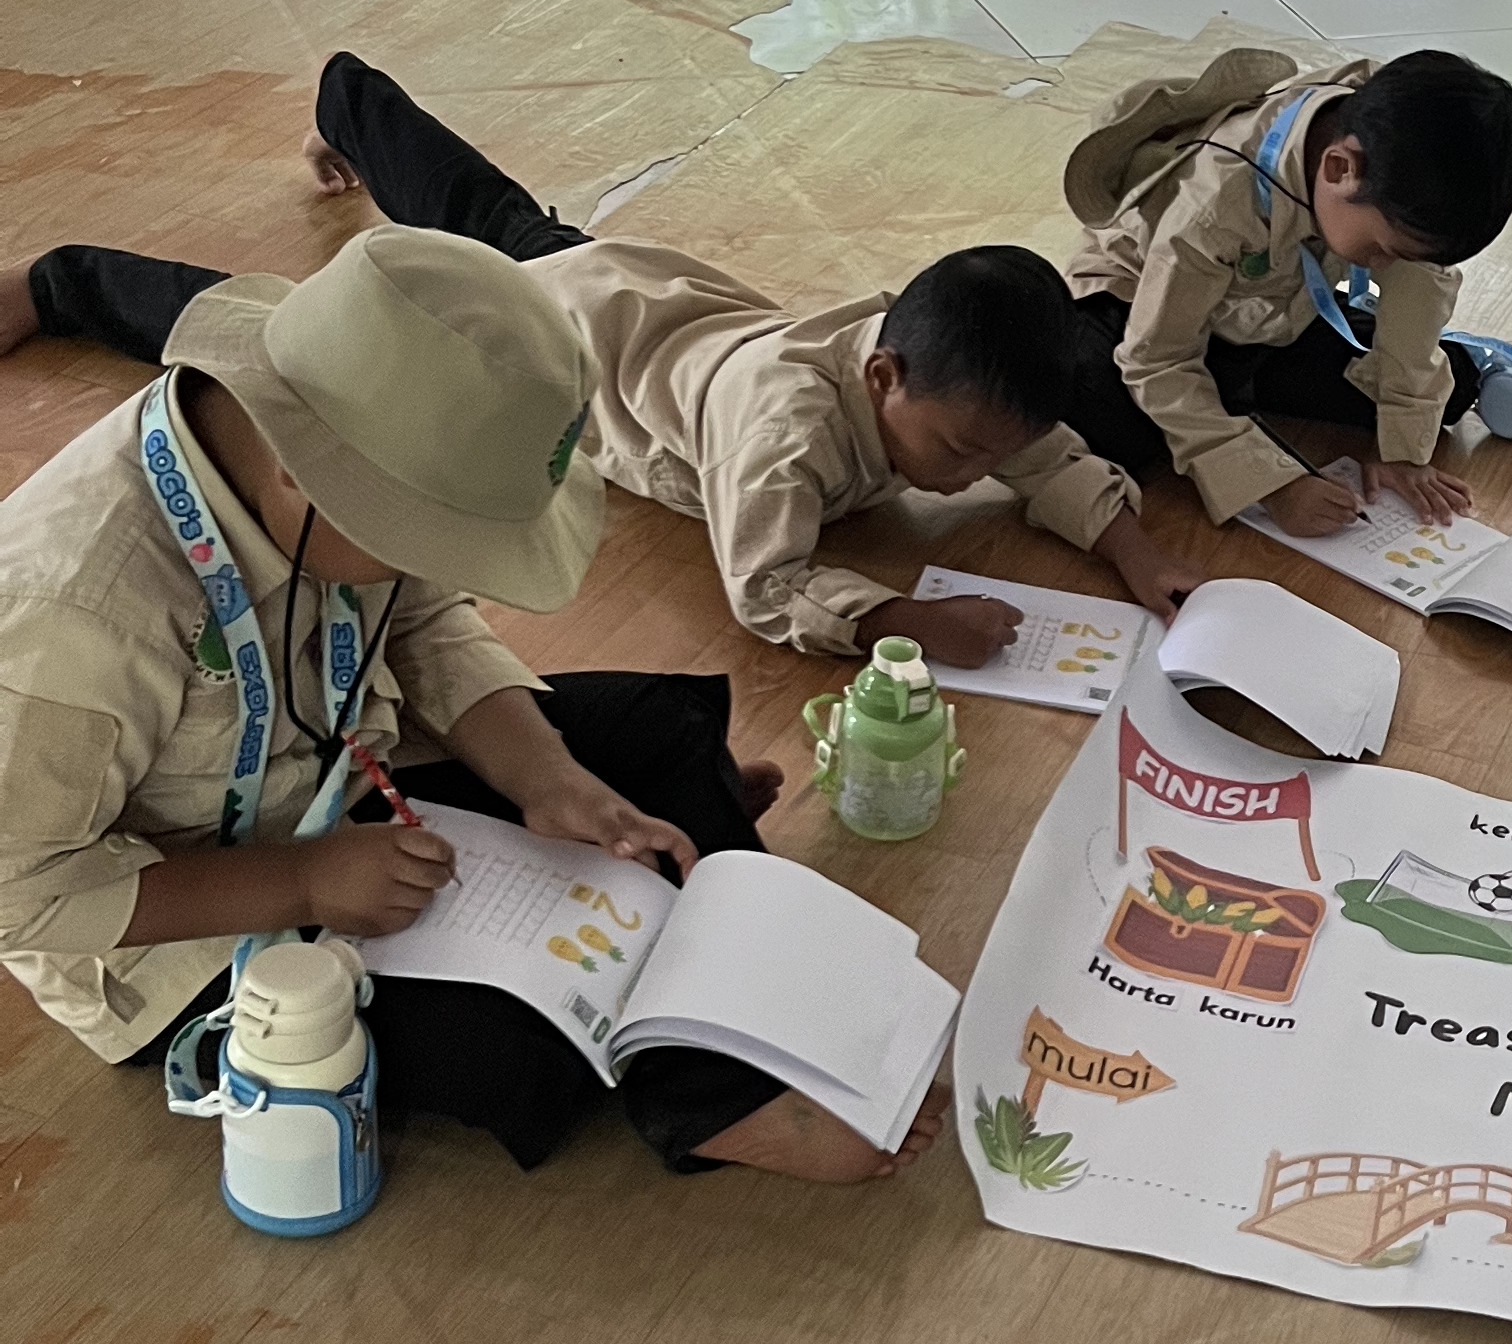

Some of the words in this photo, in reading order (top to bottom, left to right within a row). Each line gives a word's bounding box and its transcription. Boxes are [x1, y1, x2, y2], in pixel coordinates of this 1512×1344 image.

[1135, 749, 1280, 816] FINISH
[1088, 956, 1176, 1006] Harta
[1199, 995, 1296, 1029] karun
[1027, 1031, 1152, 1090] mulai
